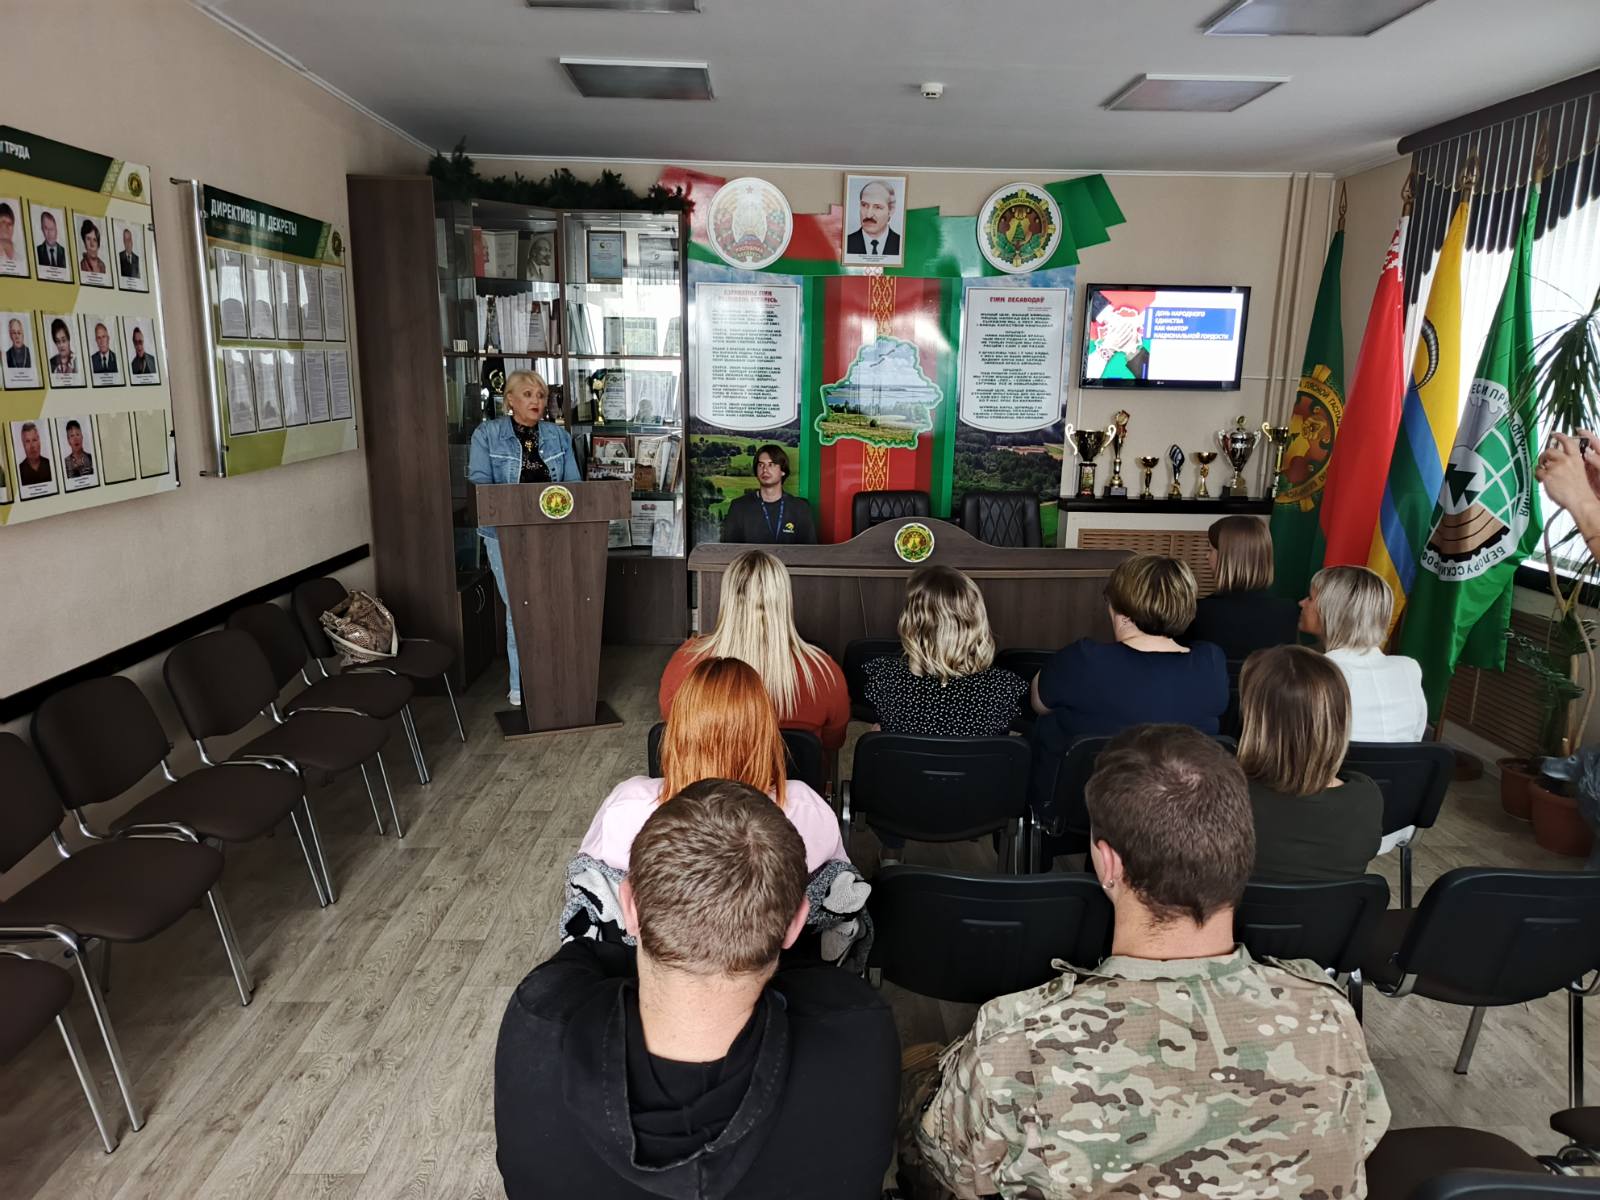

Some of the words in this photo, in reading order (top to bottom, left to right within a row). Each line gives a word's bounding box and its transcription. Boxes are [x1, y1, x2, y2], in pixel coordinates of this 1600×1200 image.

[4, 140, 31, 160] ТРУДА
[211, 199, 257, 226] ДИРЕКТИВЫ
[259, 212, 266, 231] И
[267, 215, 298, 236] ДЕКРЕТЫ
[1438, 546, 1506, 577] БЕЛОРУССКИ
